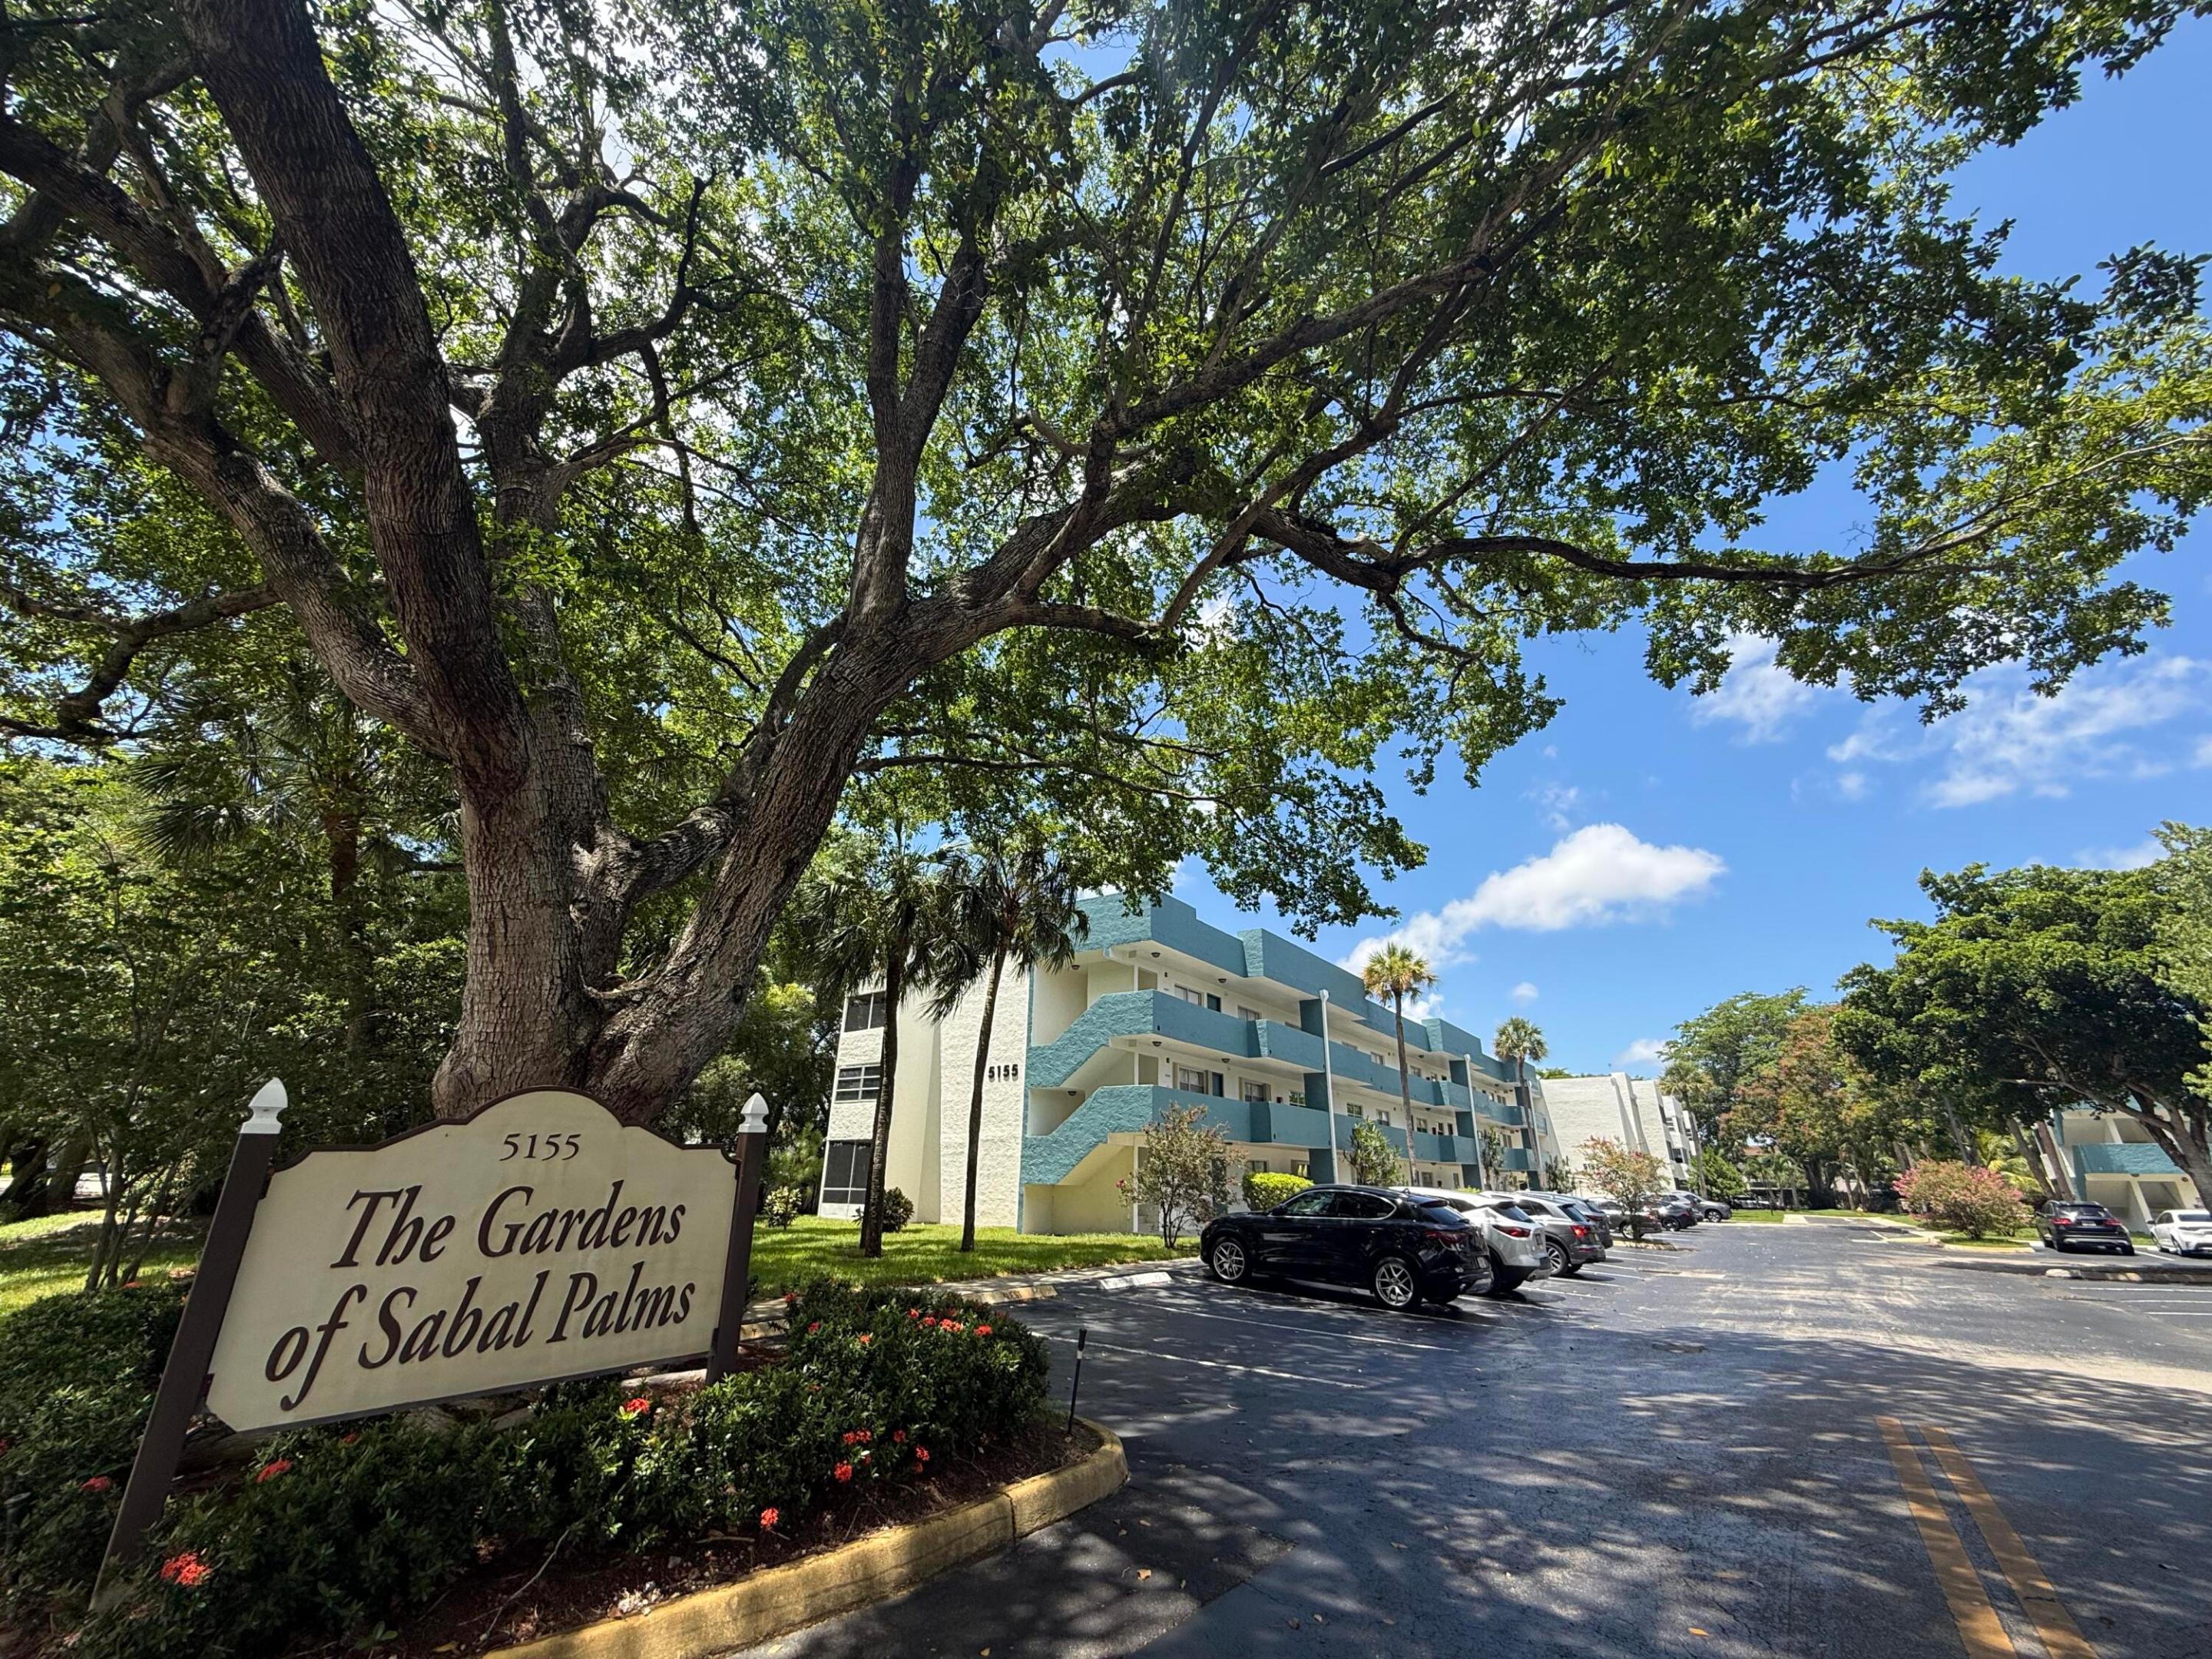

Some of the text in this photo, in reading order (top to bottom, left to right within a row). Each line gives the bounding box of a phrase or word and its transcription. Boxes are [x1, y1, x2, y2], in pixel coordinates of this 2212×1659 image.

[988, 1064, 1018, 1079] 5155
[499, 1132, 582, 1162] 5155
[329, 1180, 687, 1270] The Gardens
[265, 1261, 696, 1412] of Sabal Palms
